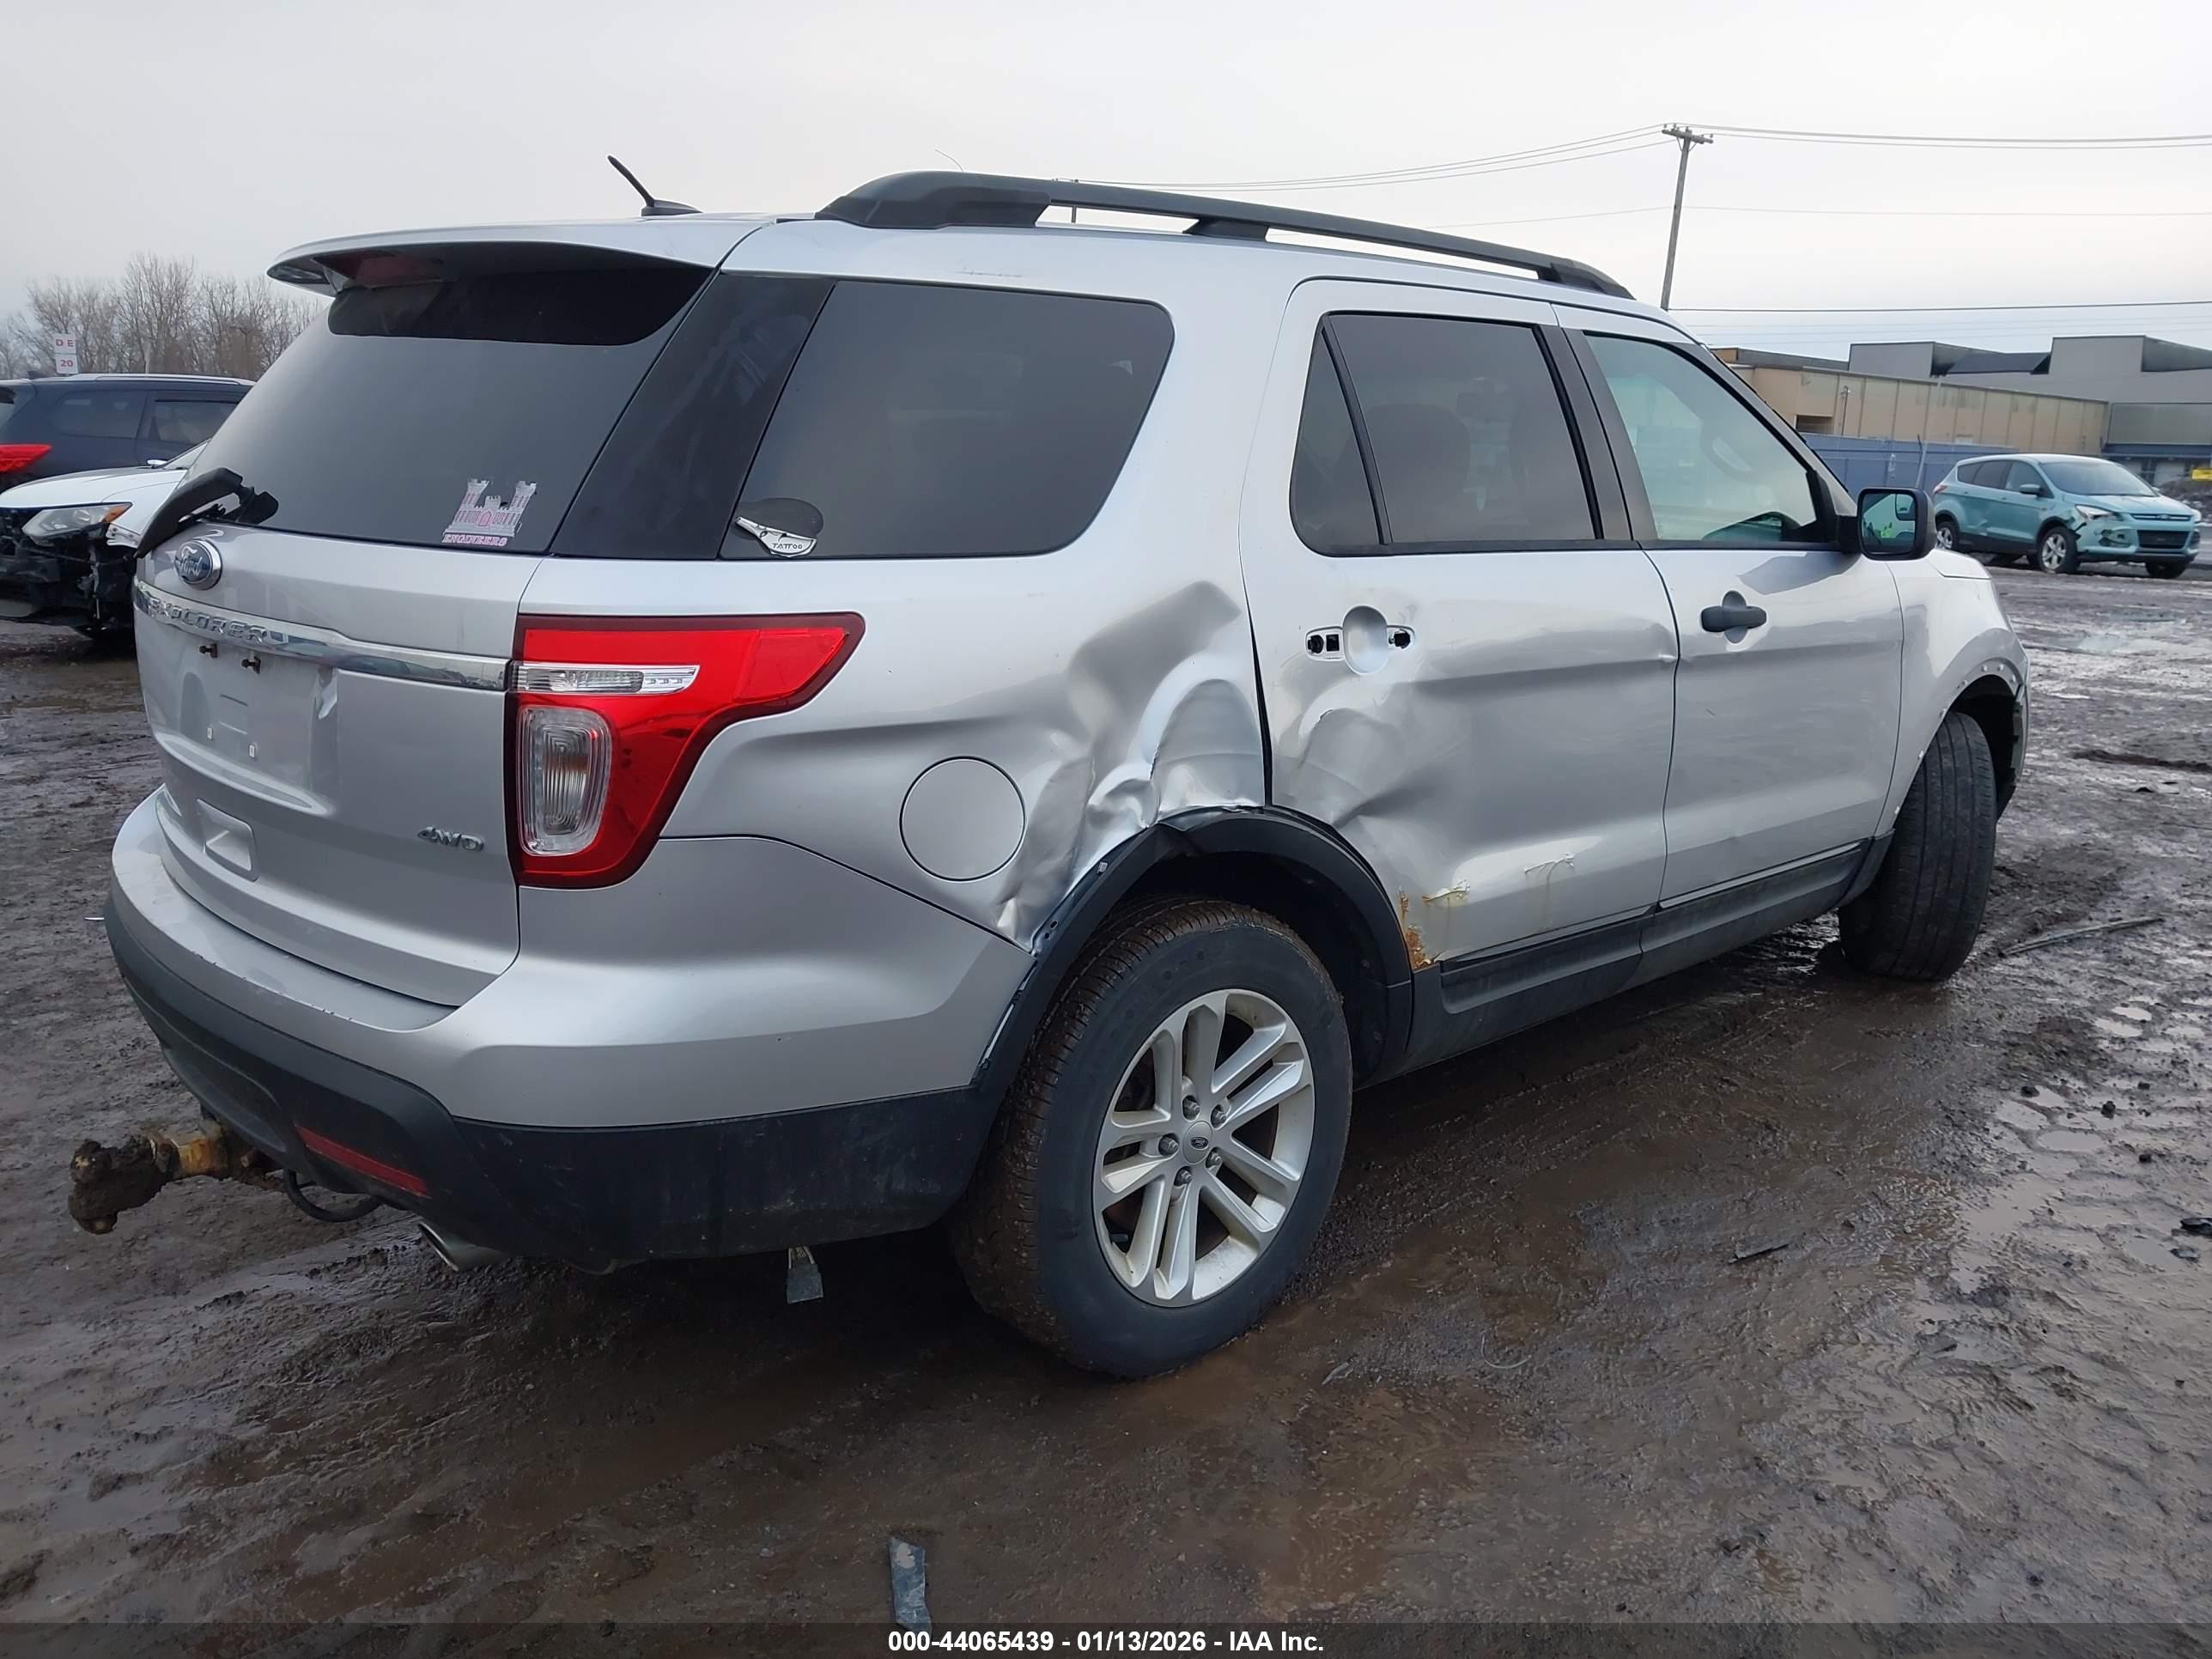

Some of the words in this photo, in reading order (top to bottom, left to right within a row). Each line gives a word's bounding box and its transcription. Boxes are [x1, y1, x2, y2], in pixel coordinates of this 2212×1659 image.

[60, 359, 74, 368] 20
[176, 546, 203, 577] Ford
[417, 826, 484, 852] 4WD
